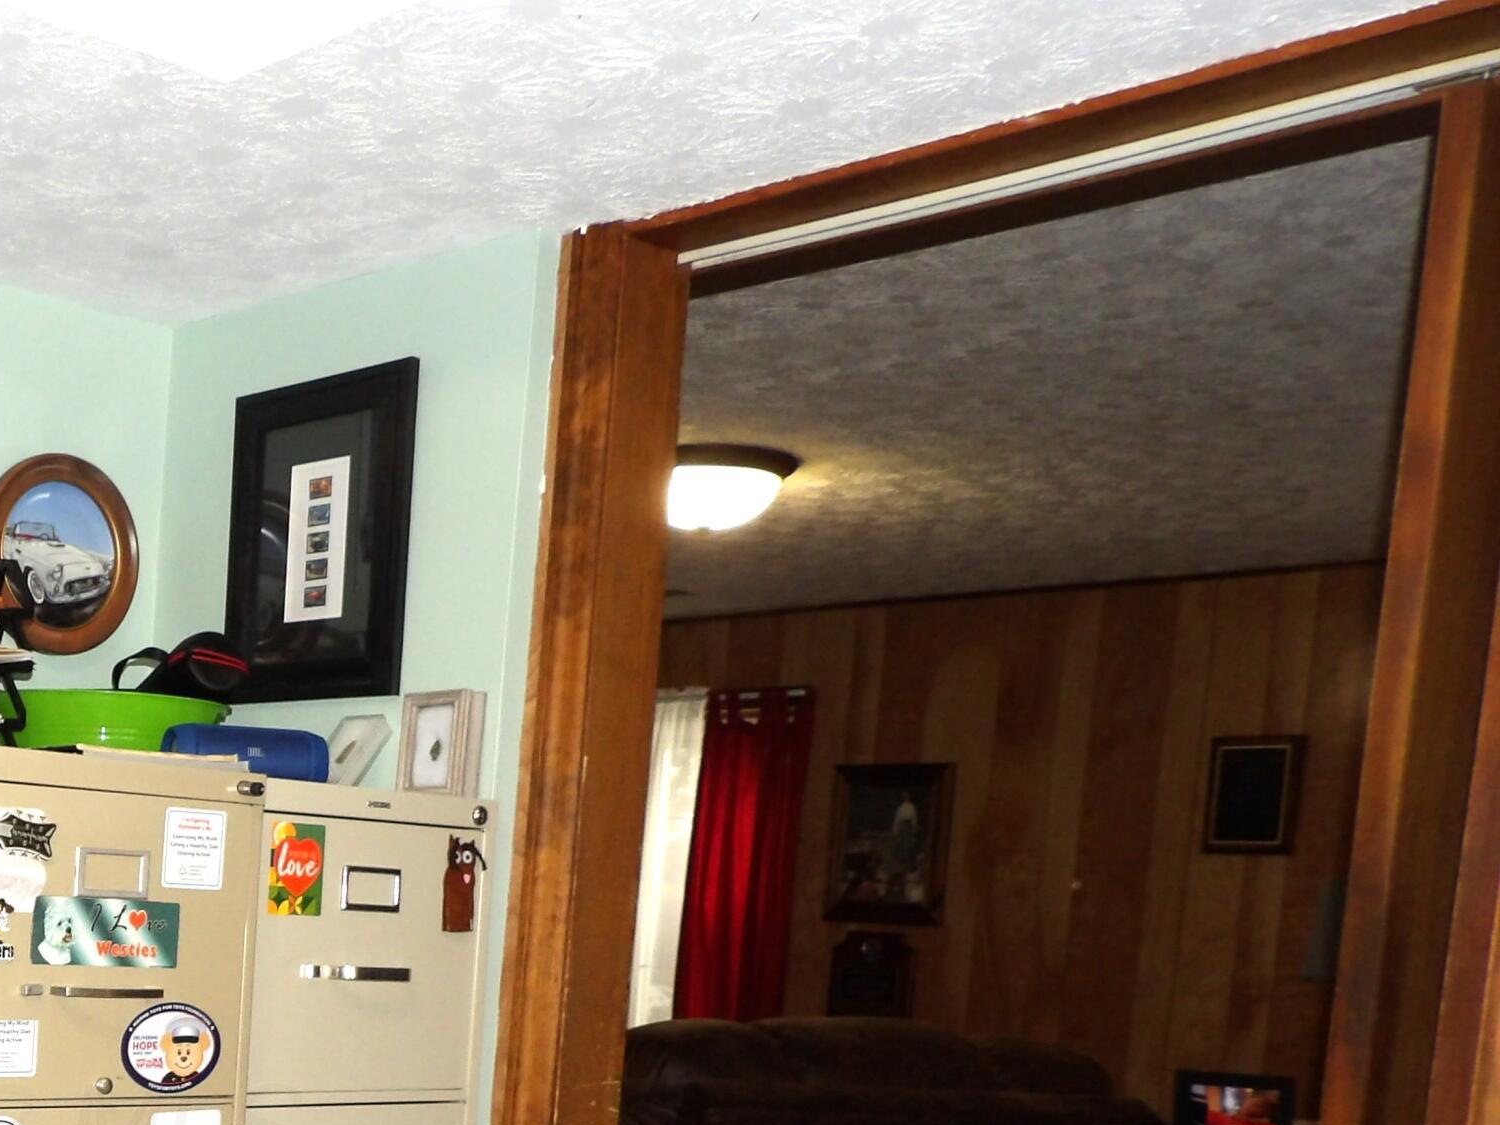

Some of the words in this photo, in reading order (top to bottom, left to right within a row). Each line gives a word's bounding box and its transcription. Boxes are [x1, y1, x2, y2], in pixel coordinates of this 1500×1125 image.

[278, 842, 318, 877] love
[96, 940, 157, 958] Westies
[133, 1041, 158, 1050] HOPE
